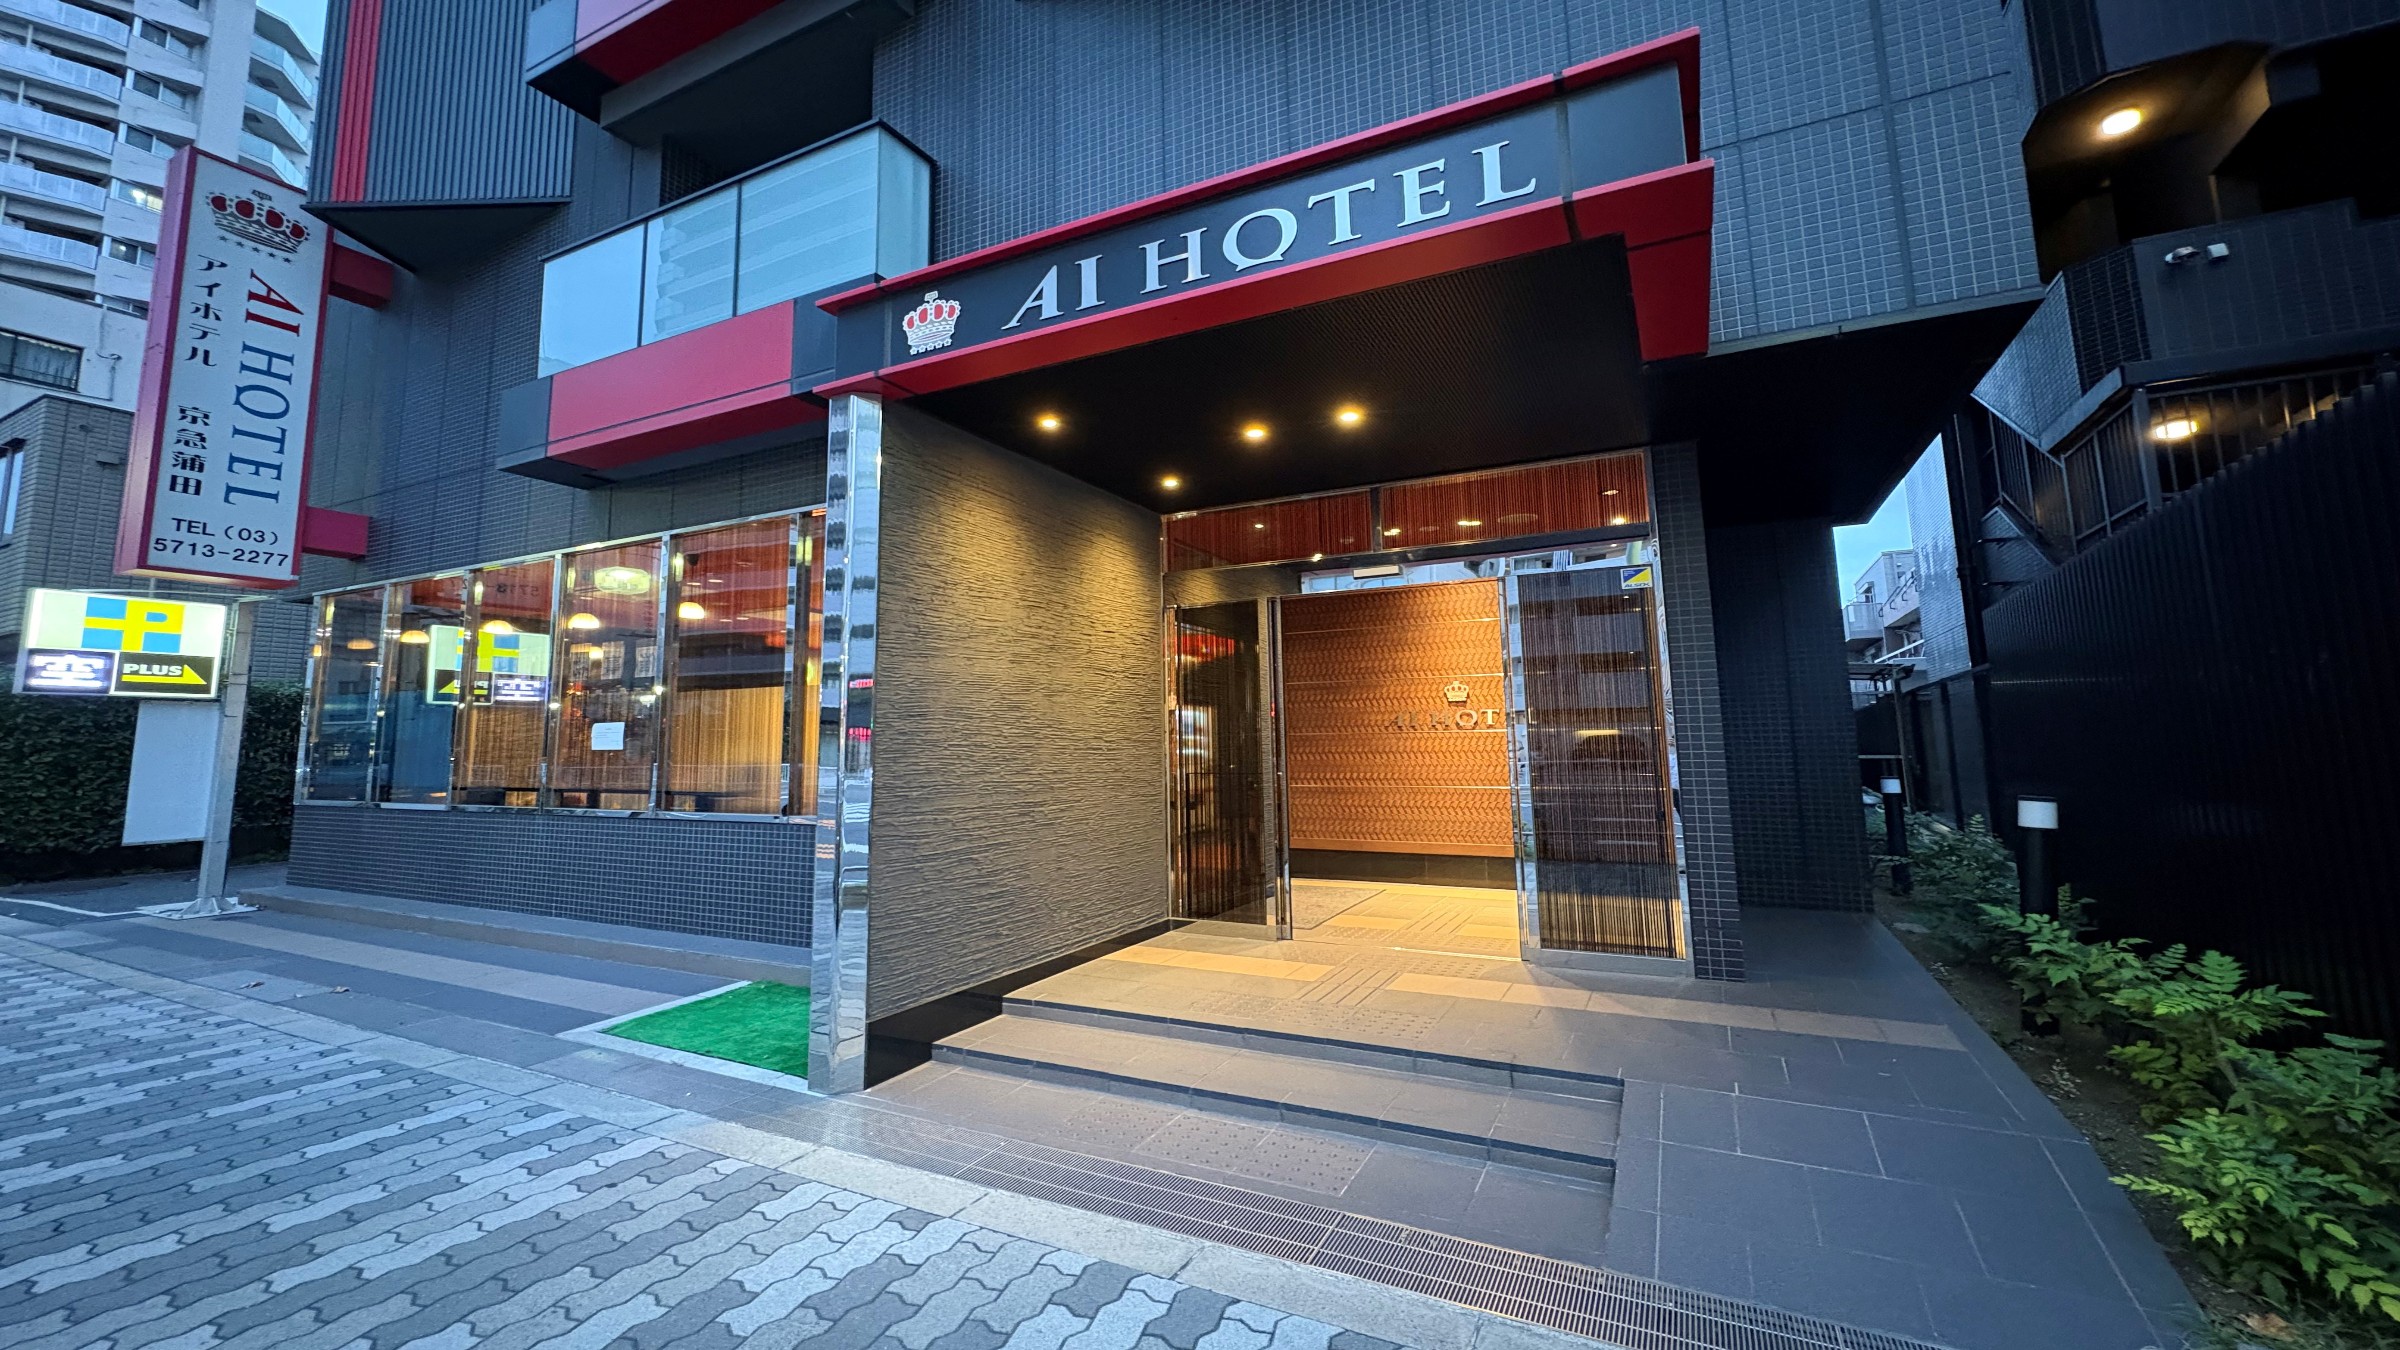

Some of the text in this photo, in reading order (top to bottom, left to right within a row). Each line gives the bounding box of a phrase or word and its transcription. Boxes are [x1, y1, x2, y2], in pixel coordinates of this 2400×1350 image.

[1001, 140, 1537, 330] AI HOTEL
[169, 254, 228, 496] アイホテル 京急蒲田
[223, 268, 304, 506] AI HOTEL
[153, 537, 289, 567] 5713-2277
[122, 663, 183, 676] PLUS
